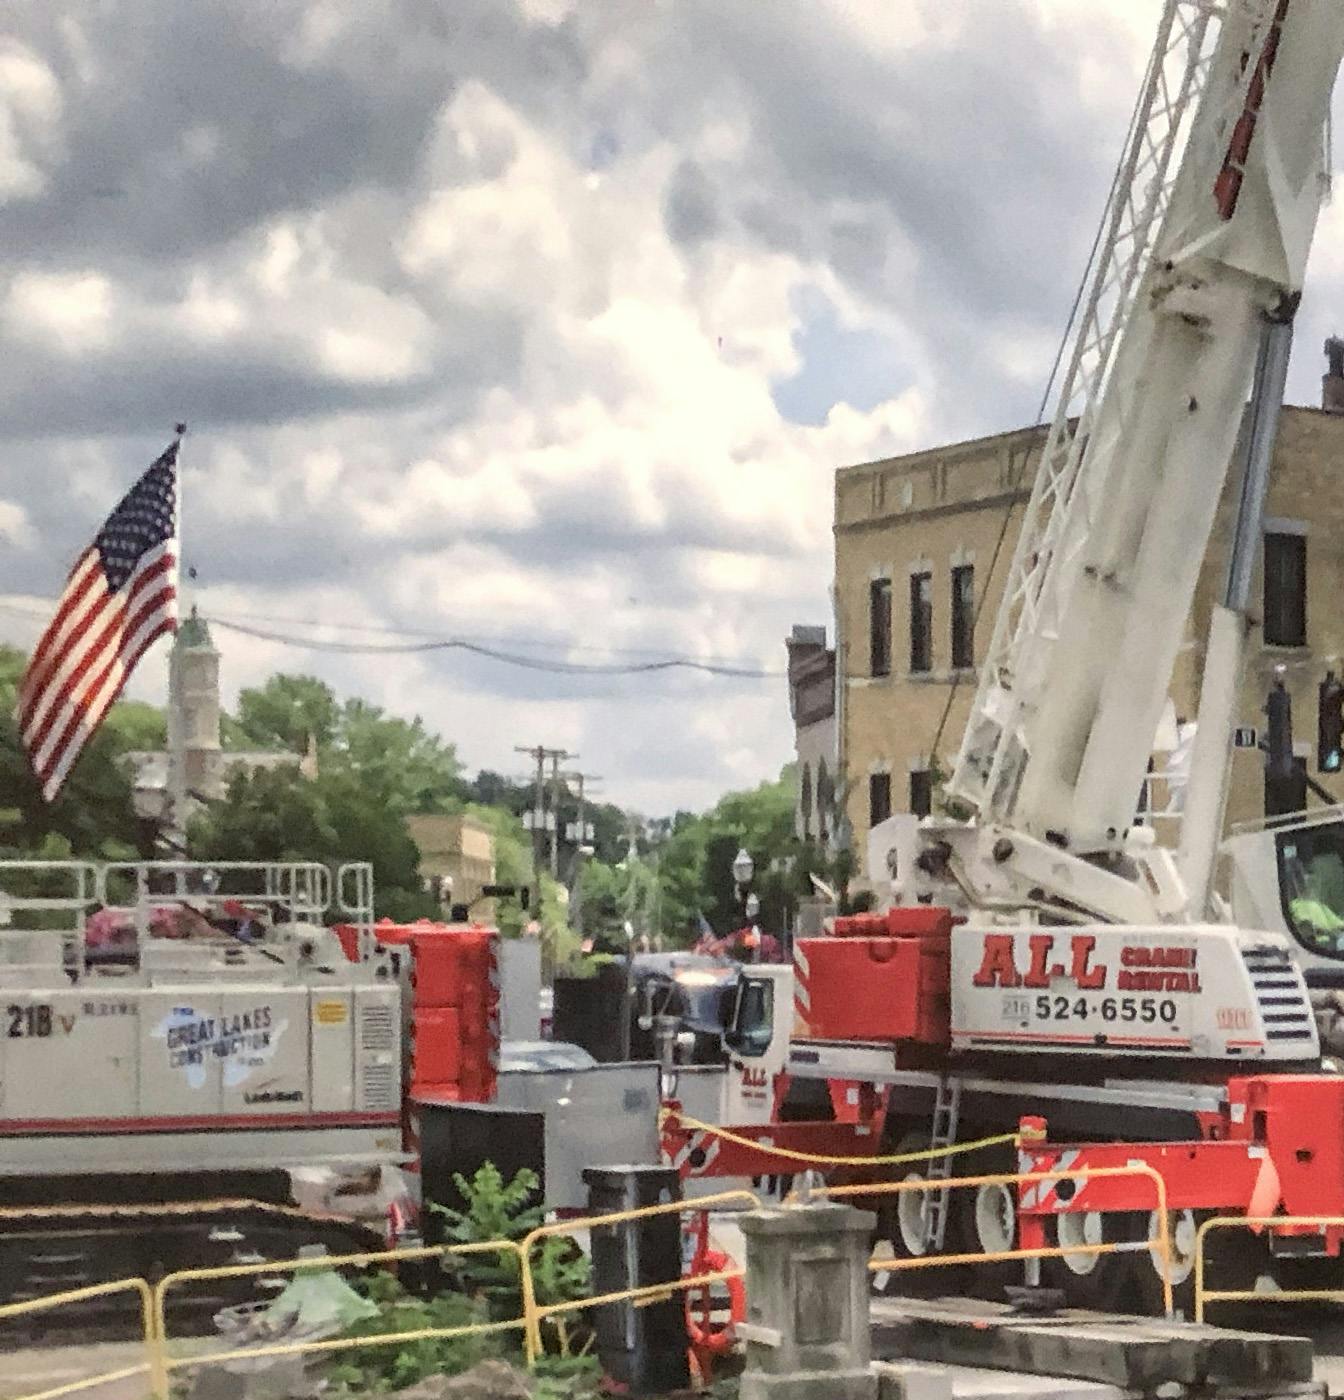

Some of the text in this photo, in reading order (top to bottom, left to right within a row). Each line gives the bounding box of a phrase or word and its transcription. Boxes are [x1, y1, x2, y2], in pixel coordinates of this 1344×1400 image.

[972, 934, 1107, 989] ALL
[1120, 947, 1198, 968] CRANE
[1117, 970, 1202, 993] RENTAL
[1002, 1000, 1030, 1016] 216
[167, 1005, 272, 1049] GREAT LAKES
